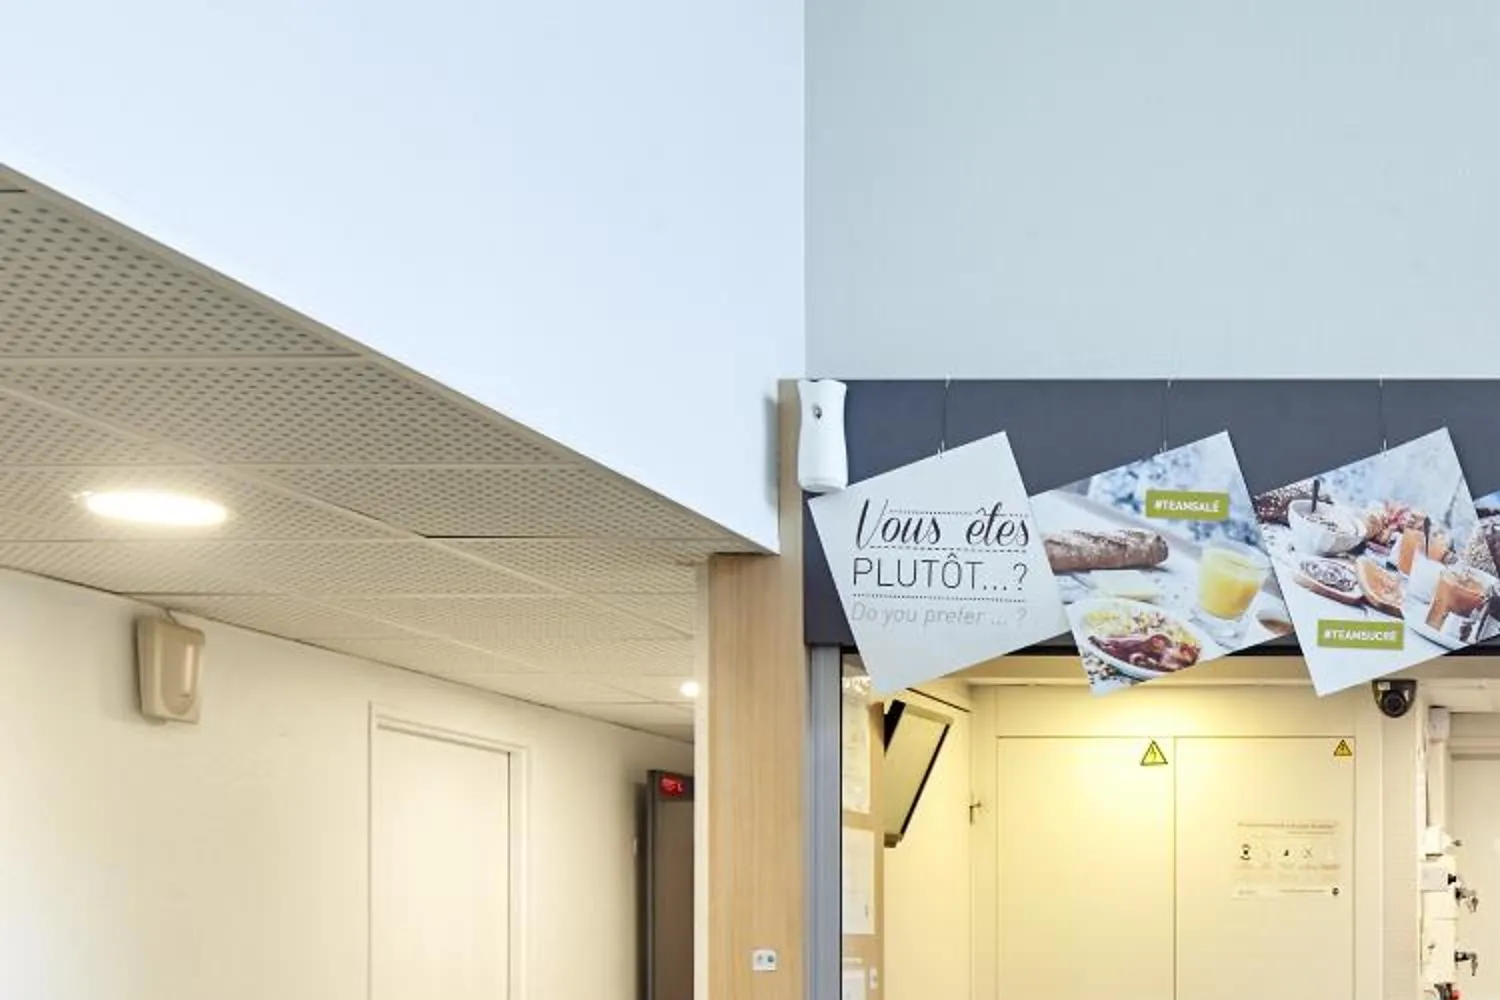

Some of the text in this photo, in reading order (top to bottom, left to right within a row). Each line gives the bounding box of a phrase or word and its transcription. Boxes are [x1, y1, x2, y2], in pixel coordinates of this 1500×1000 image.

[855, 498, 1029, 551] Vous êtes
[851, 602, 878, 622] Do
[884, 608, 918, 627] you
[924, 608, 986, 626] prefer
